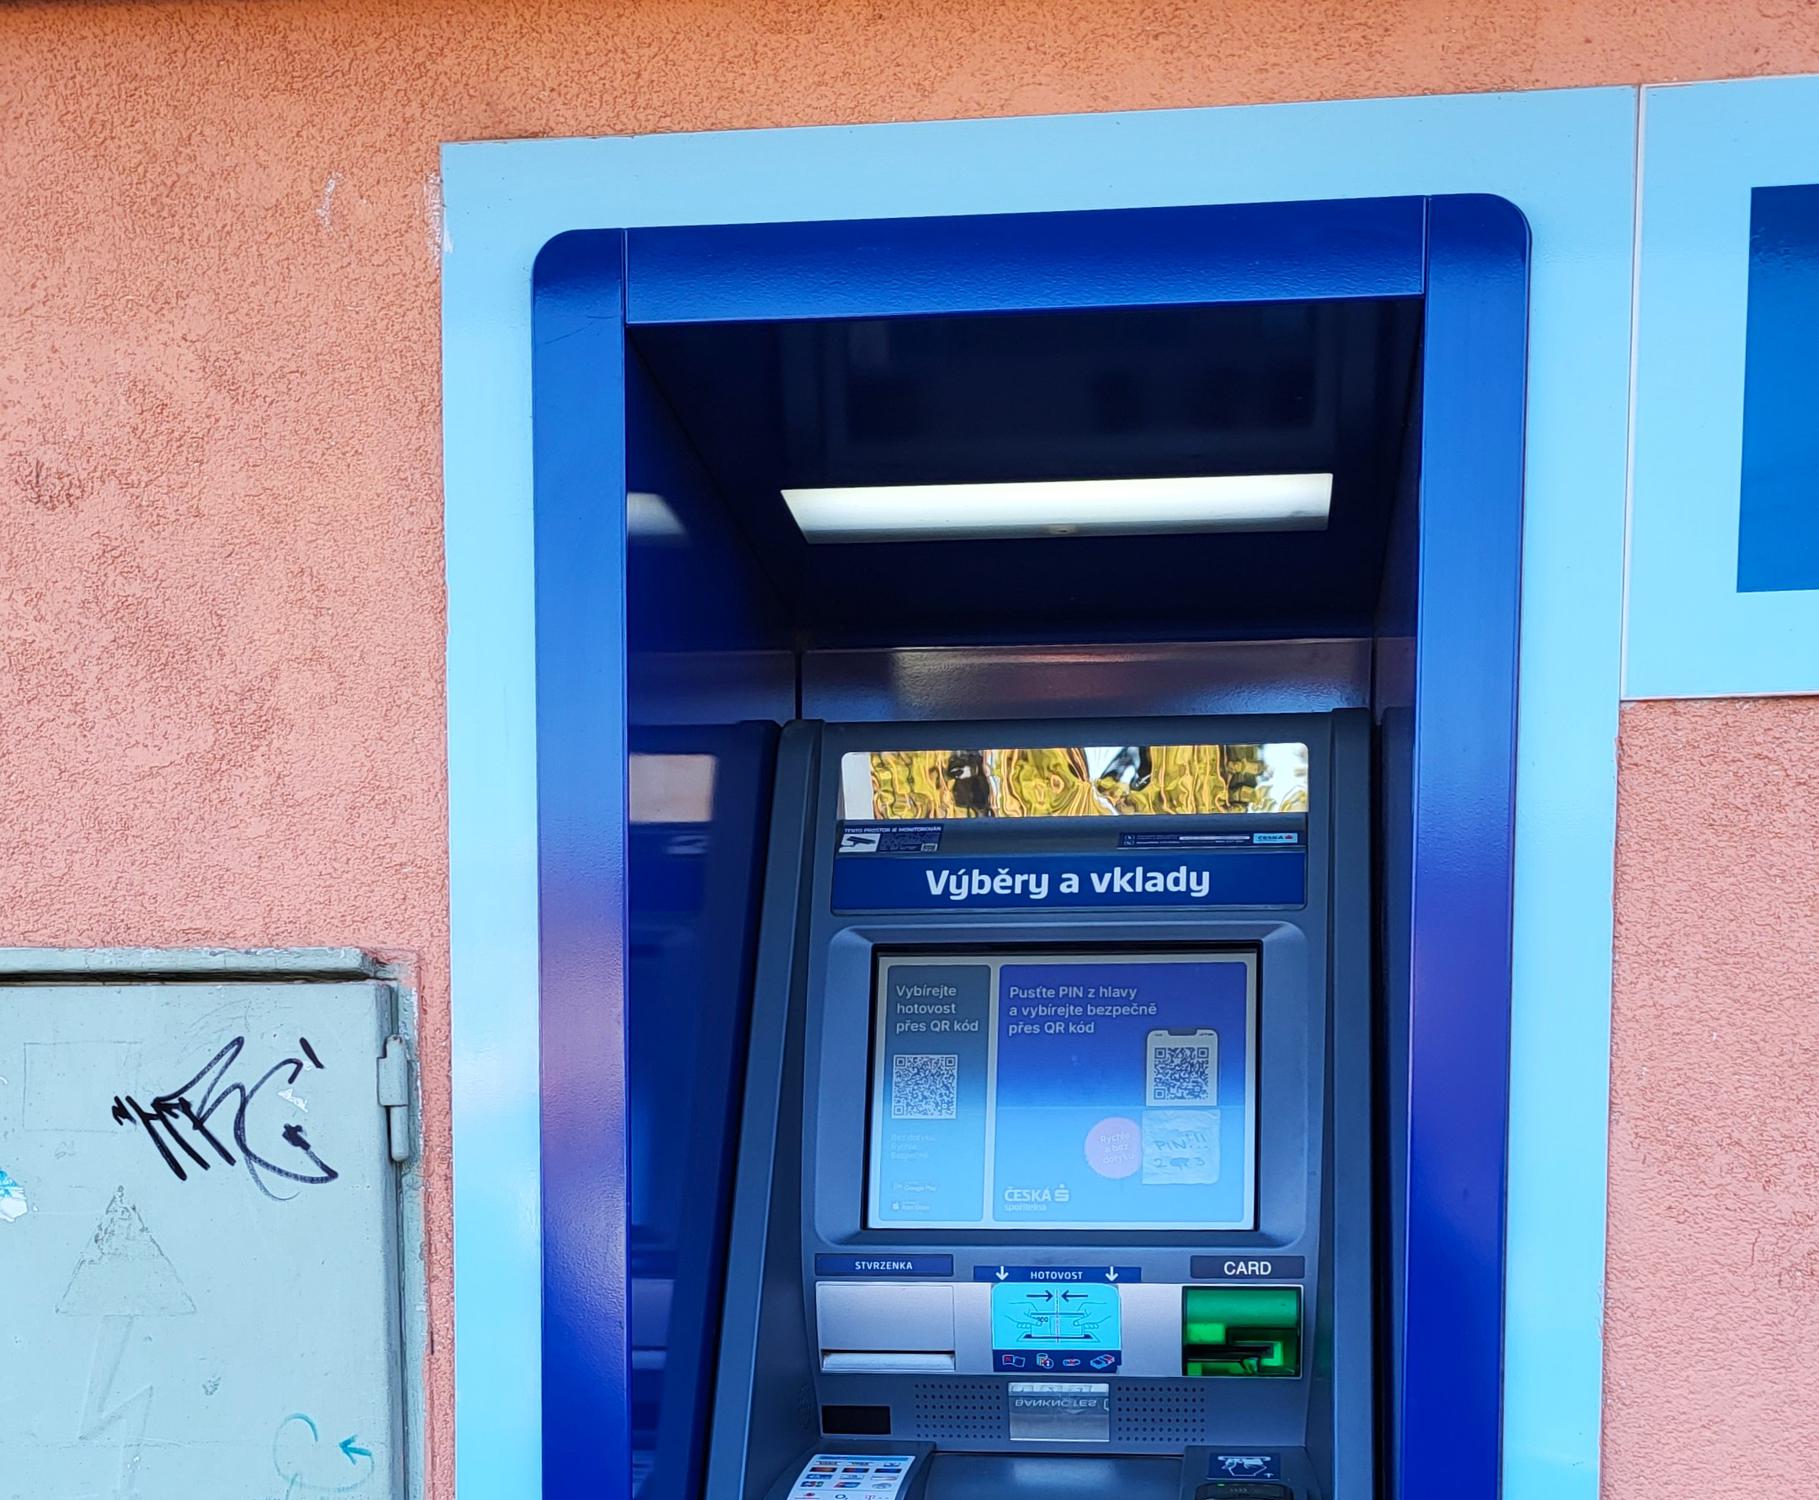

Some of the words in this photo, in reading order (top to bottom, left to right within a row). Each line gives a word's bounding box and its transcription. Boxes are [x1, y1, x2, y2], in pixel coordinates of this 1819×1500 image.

[925, 866, 1049, 901] Výběry
[1059, 874, 1080, 894] a
[1089, 865, 1211, 897] vklady
[895, 984, 957, 999] Vybírejte
[1009, 985, 1056, 998] Pusťte
[1059, 986, 1084, 998] PIN
[1087, 988, 1096, 998] z
[1099, 985, 1138, 1001] hlavy
[896, 1003, 957, 1014] hotovost
[1008, 1006, 1018, 1016] a
[1021, 1003, 1084, 1019] vybírejte
[1087, 1002, 1158, 1018] bezpečně
[896, 1019, 927, 1035] přes
[930, 1019, 951, 1032] QR
[953, 1018, 979, 1032] kód
[1008, 1020, 1041, 1037] přes
[1044, 1021, 1065, 1034] QR
[1068, 1020, 1095, 1034] kód
[1004, 1185, 1052, 1202] ČESKÁ
[854, 1259, 913, 1271] STVRZENKA
[1223, 1261, 1272, 1276] CARD
[1030, 1271, 1083, 1280] HOTOVOST
